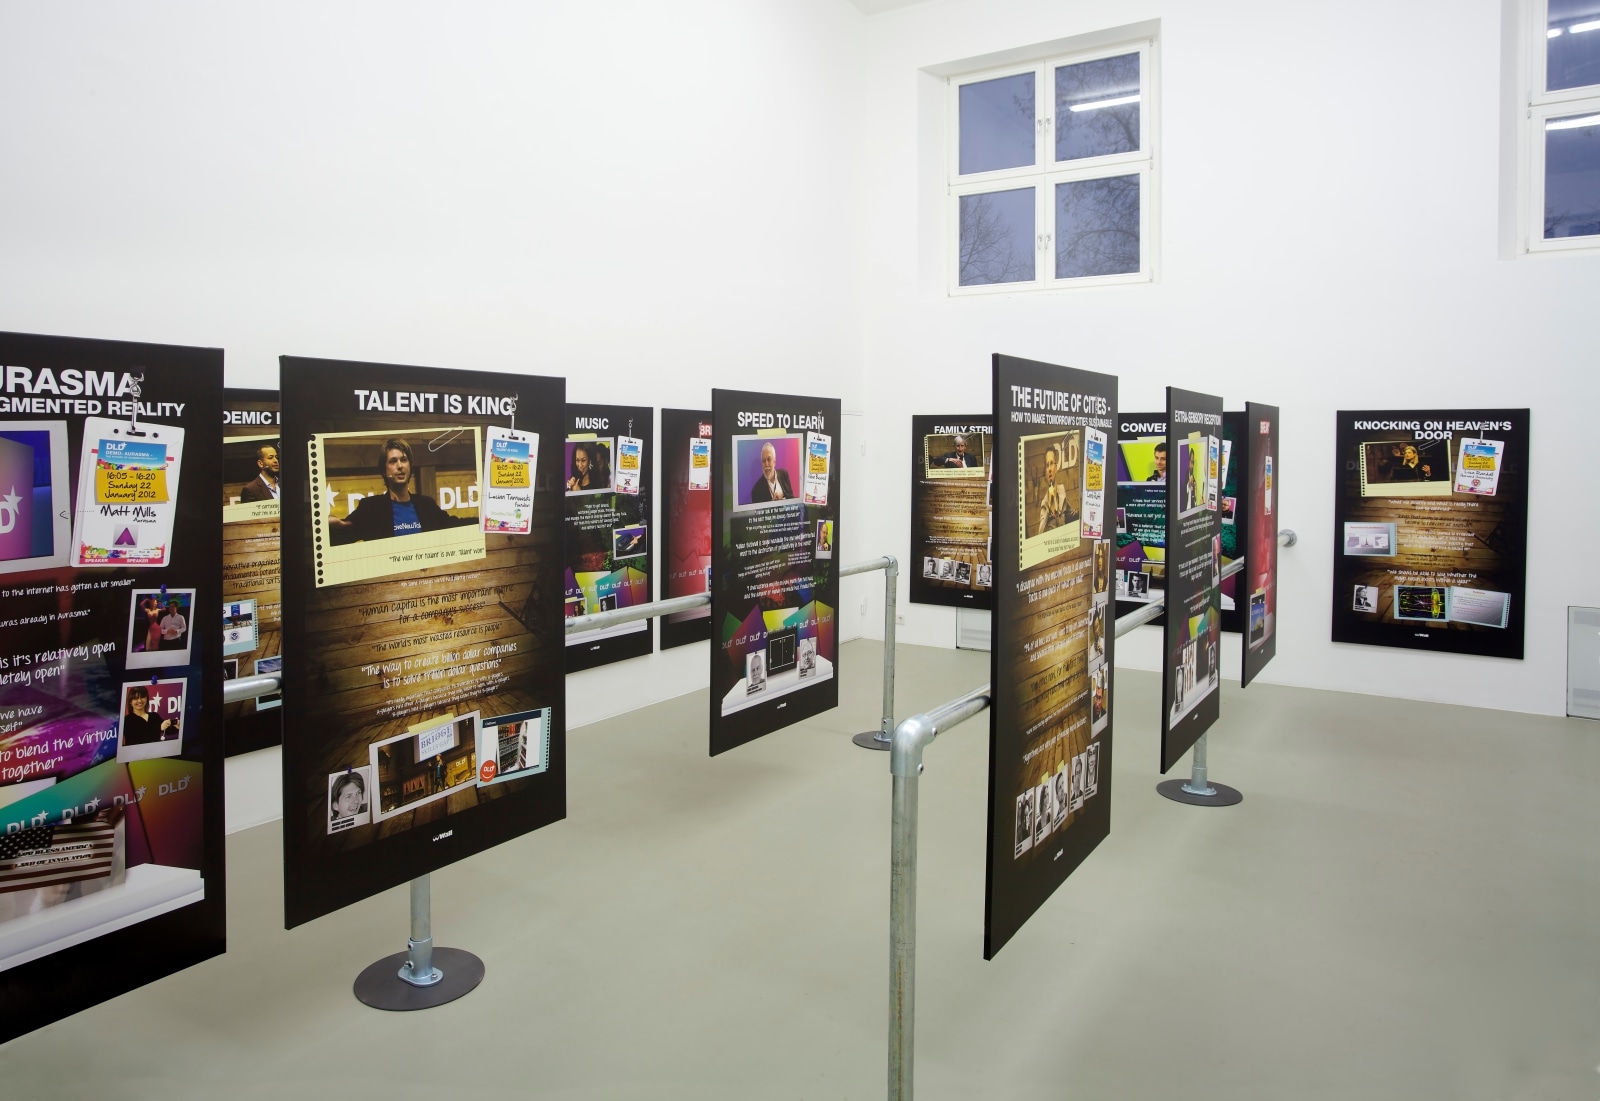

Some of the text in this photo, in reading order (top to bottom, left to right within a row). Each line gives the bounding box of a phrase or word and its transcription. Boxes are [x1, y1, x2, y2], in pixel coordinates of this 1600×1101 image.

[354, 390, 513, 416] TALENT IS KING
[1011, 385, 1032, 409] THE
[1034, 388, 1069, 412] FUTURE
[1071, 393, 1081, 414] OF
[108, 401, 185, 417] REALITY
[576, 417, 609, 430] MUSIC
[738, 412, 825, 430] SPEED TO LEARN
[1011, 411, 1023, 423] HOW
[1024, 412, 1031, 423] TO
[1032, 413, 1045, 424] MAKE
[934, 426, 967, 435] FAMILY
[1354, 421, 1421, 431] KNOCKING
[1424, 421, 1442, 431] ON
[1415, 431, 1453, 441] DOOR
[106, 442, 125, 451] DLD
[106, 472, 156, 480] 16:05 16:20
[108, 481, 138, 492] Sunday
[104, 490, 136, 501] January
[440, 486, 479, 510] DLD
[100, 504, 157, 518] Matt Mills
[402, 554, 414, 562] war
[2, 590, 10, 598] to
[12, 588, 24, 596] the
[26, 586, 54, 595] internet
[55, 585, 69, 593] has
[71, 583, 92, 594] gotten
[391, 600, 418, 614] Capital
[420, 598, 426, 607] is
[427, 596, 440, 605] the
[442, 593, 458, 603] most
[461, 587, 492, 603] important
[20, 615, 48, 624] already
[49, 613, 56, 621] in
[399, 614, 410, 625] for
[413, 636, 429, 645] most
[430, 631, 452, 642] wasted
[453, 627, 477, 638] resource
[479, 626, 484, 634] is
[0, 642, 116, 669] is it's relatively open
[362, 664, 380, 677] "The
[383, 662, 402, 676] way
[404, 660, 412, 670] to
[414, 657, 440, 668] create
[484, 642, 517, 658] companies
[35, 665, 65, 683] open"
[383, 678, 390, 689] is
[393, 677, 401, 687] to
[403, 674, 422, 685] solve
[18, 705, 43, 718] have
[16, 740, 49, 759] blend
[53, 737, 74, 751] the
[78, 727, 117, 746] virtual
[2, 756, 64, 783] together"
[158, 779, 189, 796] DLD
[113, 792, 143, 807] DLD
[62, 802, 97, 821] DLD
[7, 814, 45, 835] DLD
[35, 847, 61, 856] BLESS
[62, 844, 94, 853] AMERICA
[48, 854, 92, 863] INNOVATION
